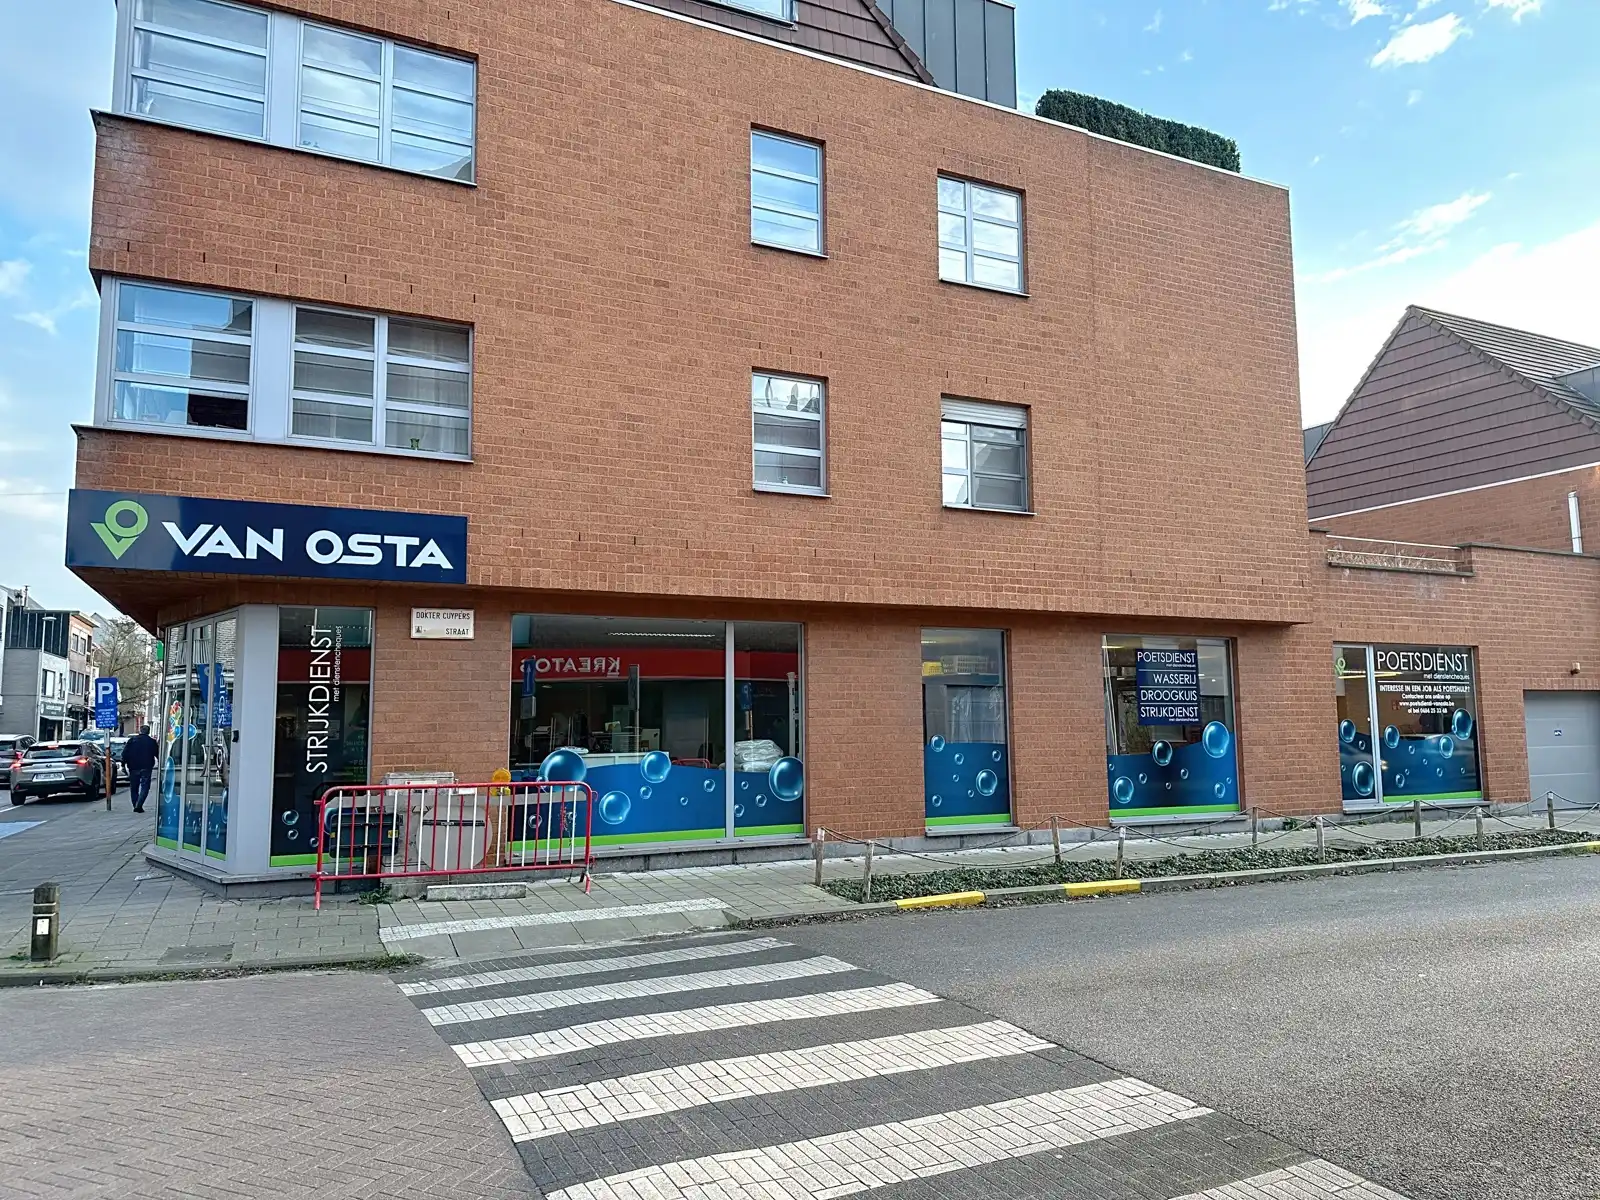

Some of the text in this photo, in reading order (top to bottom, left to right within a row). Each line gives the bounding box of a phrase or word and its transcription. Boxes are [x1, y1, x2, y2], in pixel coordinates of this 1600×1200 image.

[161, 521, 454, 569] VAN OSTA
[416, 611, 470, 620] DOKTER CUYPERS
[445, 628, 470, 636] STRAAT
[333, 625, 343, 686] dienstencheques
[1137, 651, 1195, 663] POETSDIENST
[1377, 651, 1468, 671] POETSDIENST
[1153, 673, 1197, 685] WASSERIJ
[97, 682, 114, 704] P
[1379, 684, 1404, 692] INTERESSE
[306, 625, 332, 773] STRIJKDIENST
[1140, 690, 1197, 701] DROOGKUIS
[1140, 706, 1199, 718] STRIJKDIENST
